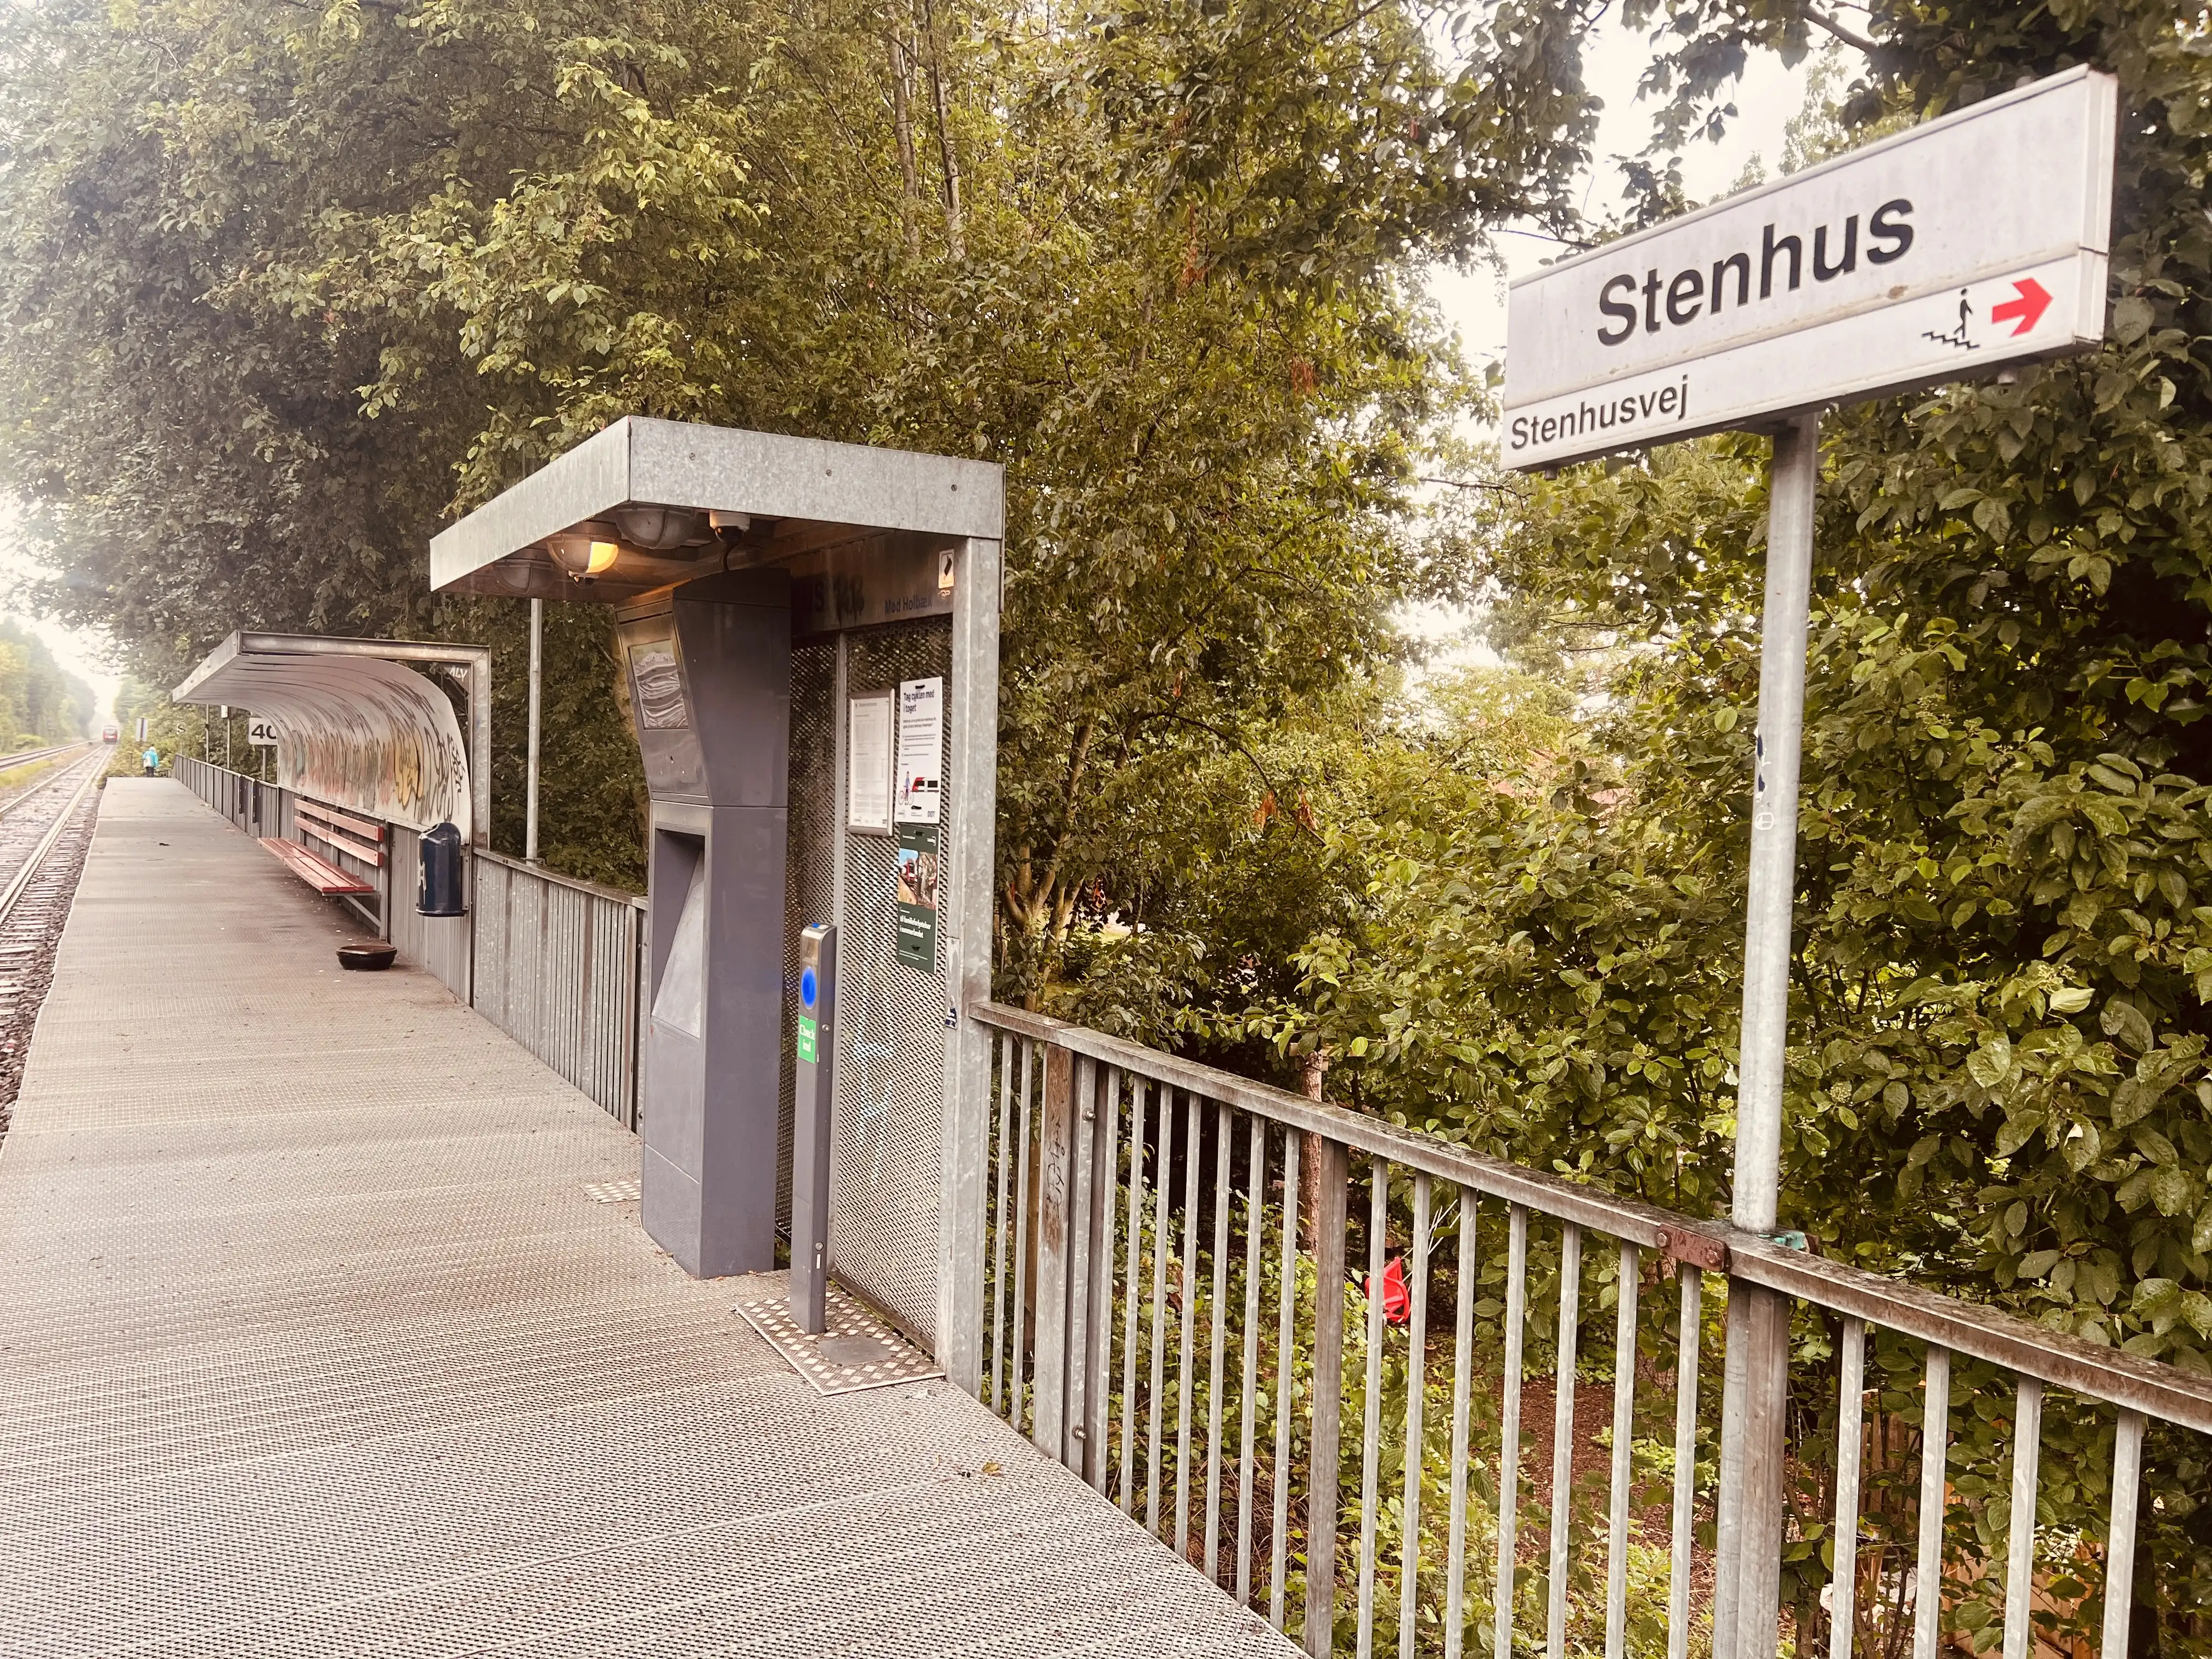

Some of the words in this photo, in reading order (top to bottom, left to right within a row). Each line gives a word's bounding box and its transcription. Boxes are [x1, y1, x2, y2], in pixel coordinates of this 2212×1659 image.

[1597, 199, 1915, 346] Stenhus
[1511, 374, 1688, 450] Stenhusvej
[884, 598, 901, 614] Mod
[903, 594, 932, 611] Holbæk
[799, 1024, 815, 1041] Check
